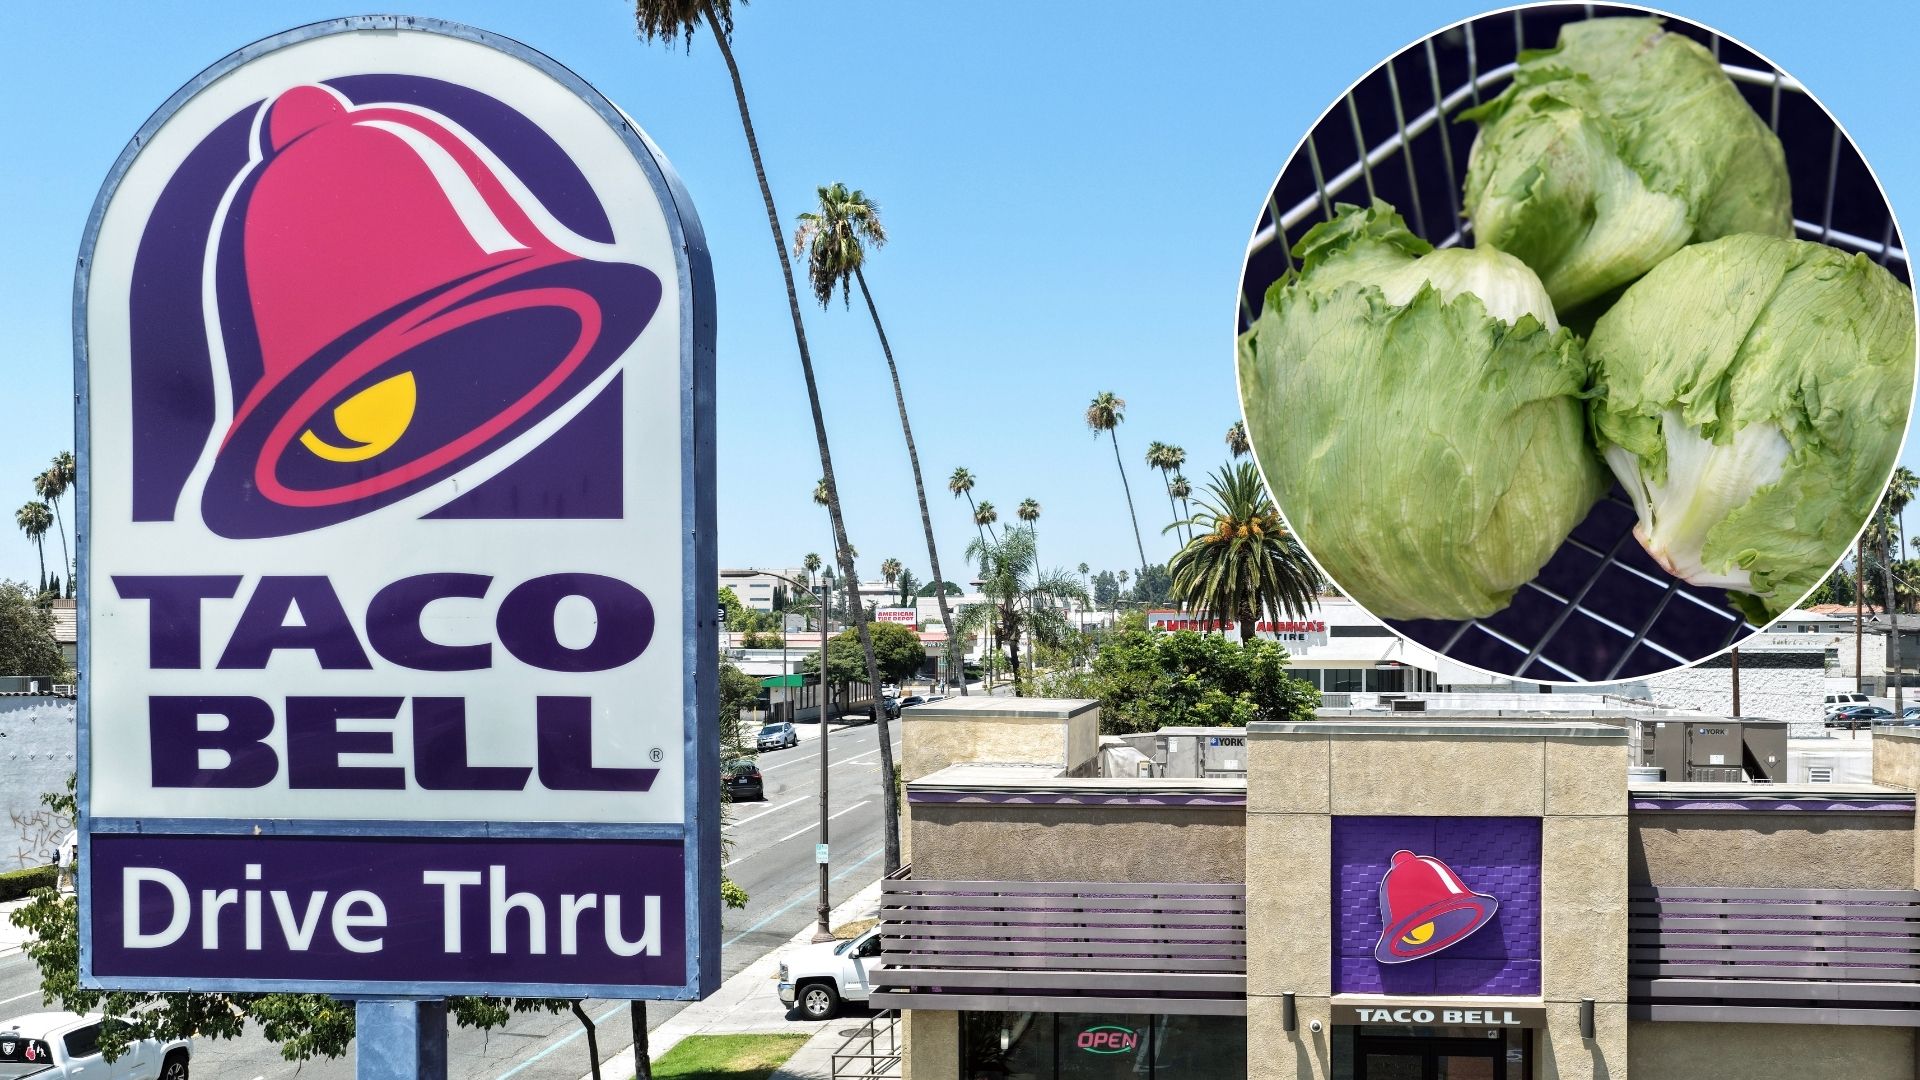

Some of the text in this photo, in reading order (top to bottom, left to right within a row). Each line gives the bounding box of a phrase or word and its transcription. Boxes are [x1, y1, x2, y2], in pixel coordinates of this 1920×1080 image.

[111, 572, 655, 673] TACO
[1277, 633, 1305, 641] TIRE
[148, 695, 660, 792] BELL
[1219, 737, 1244, 747] YORK
[122, 863, 663, 958] Drive Thru
[1355, 1008, 1521, 1025] TACO BELL
[1077, 1032, 1137, 1048] OPEN
